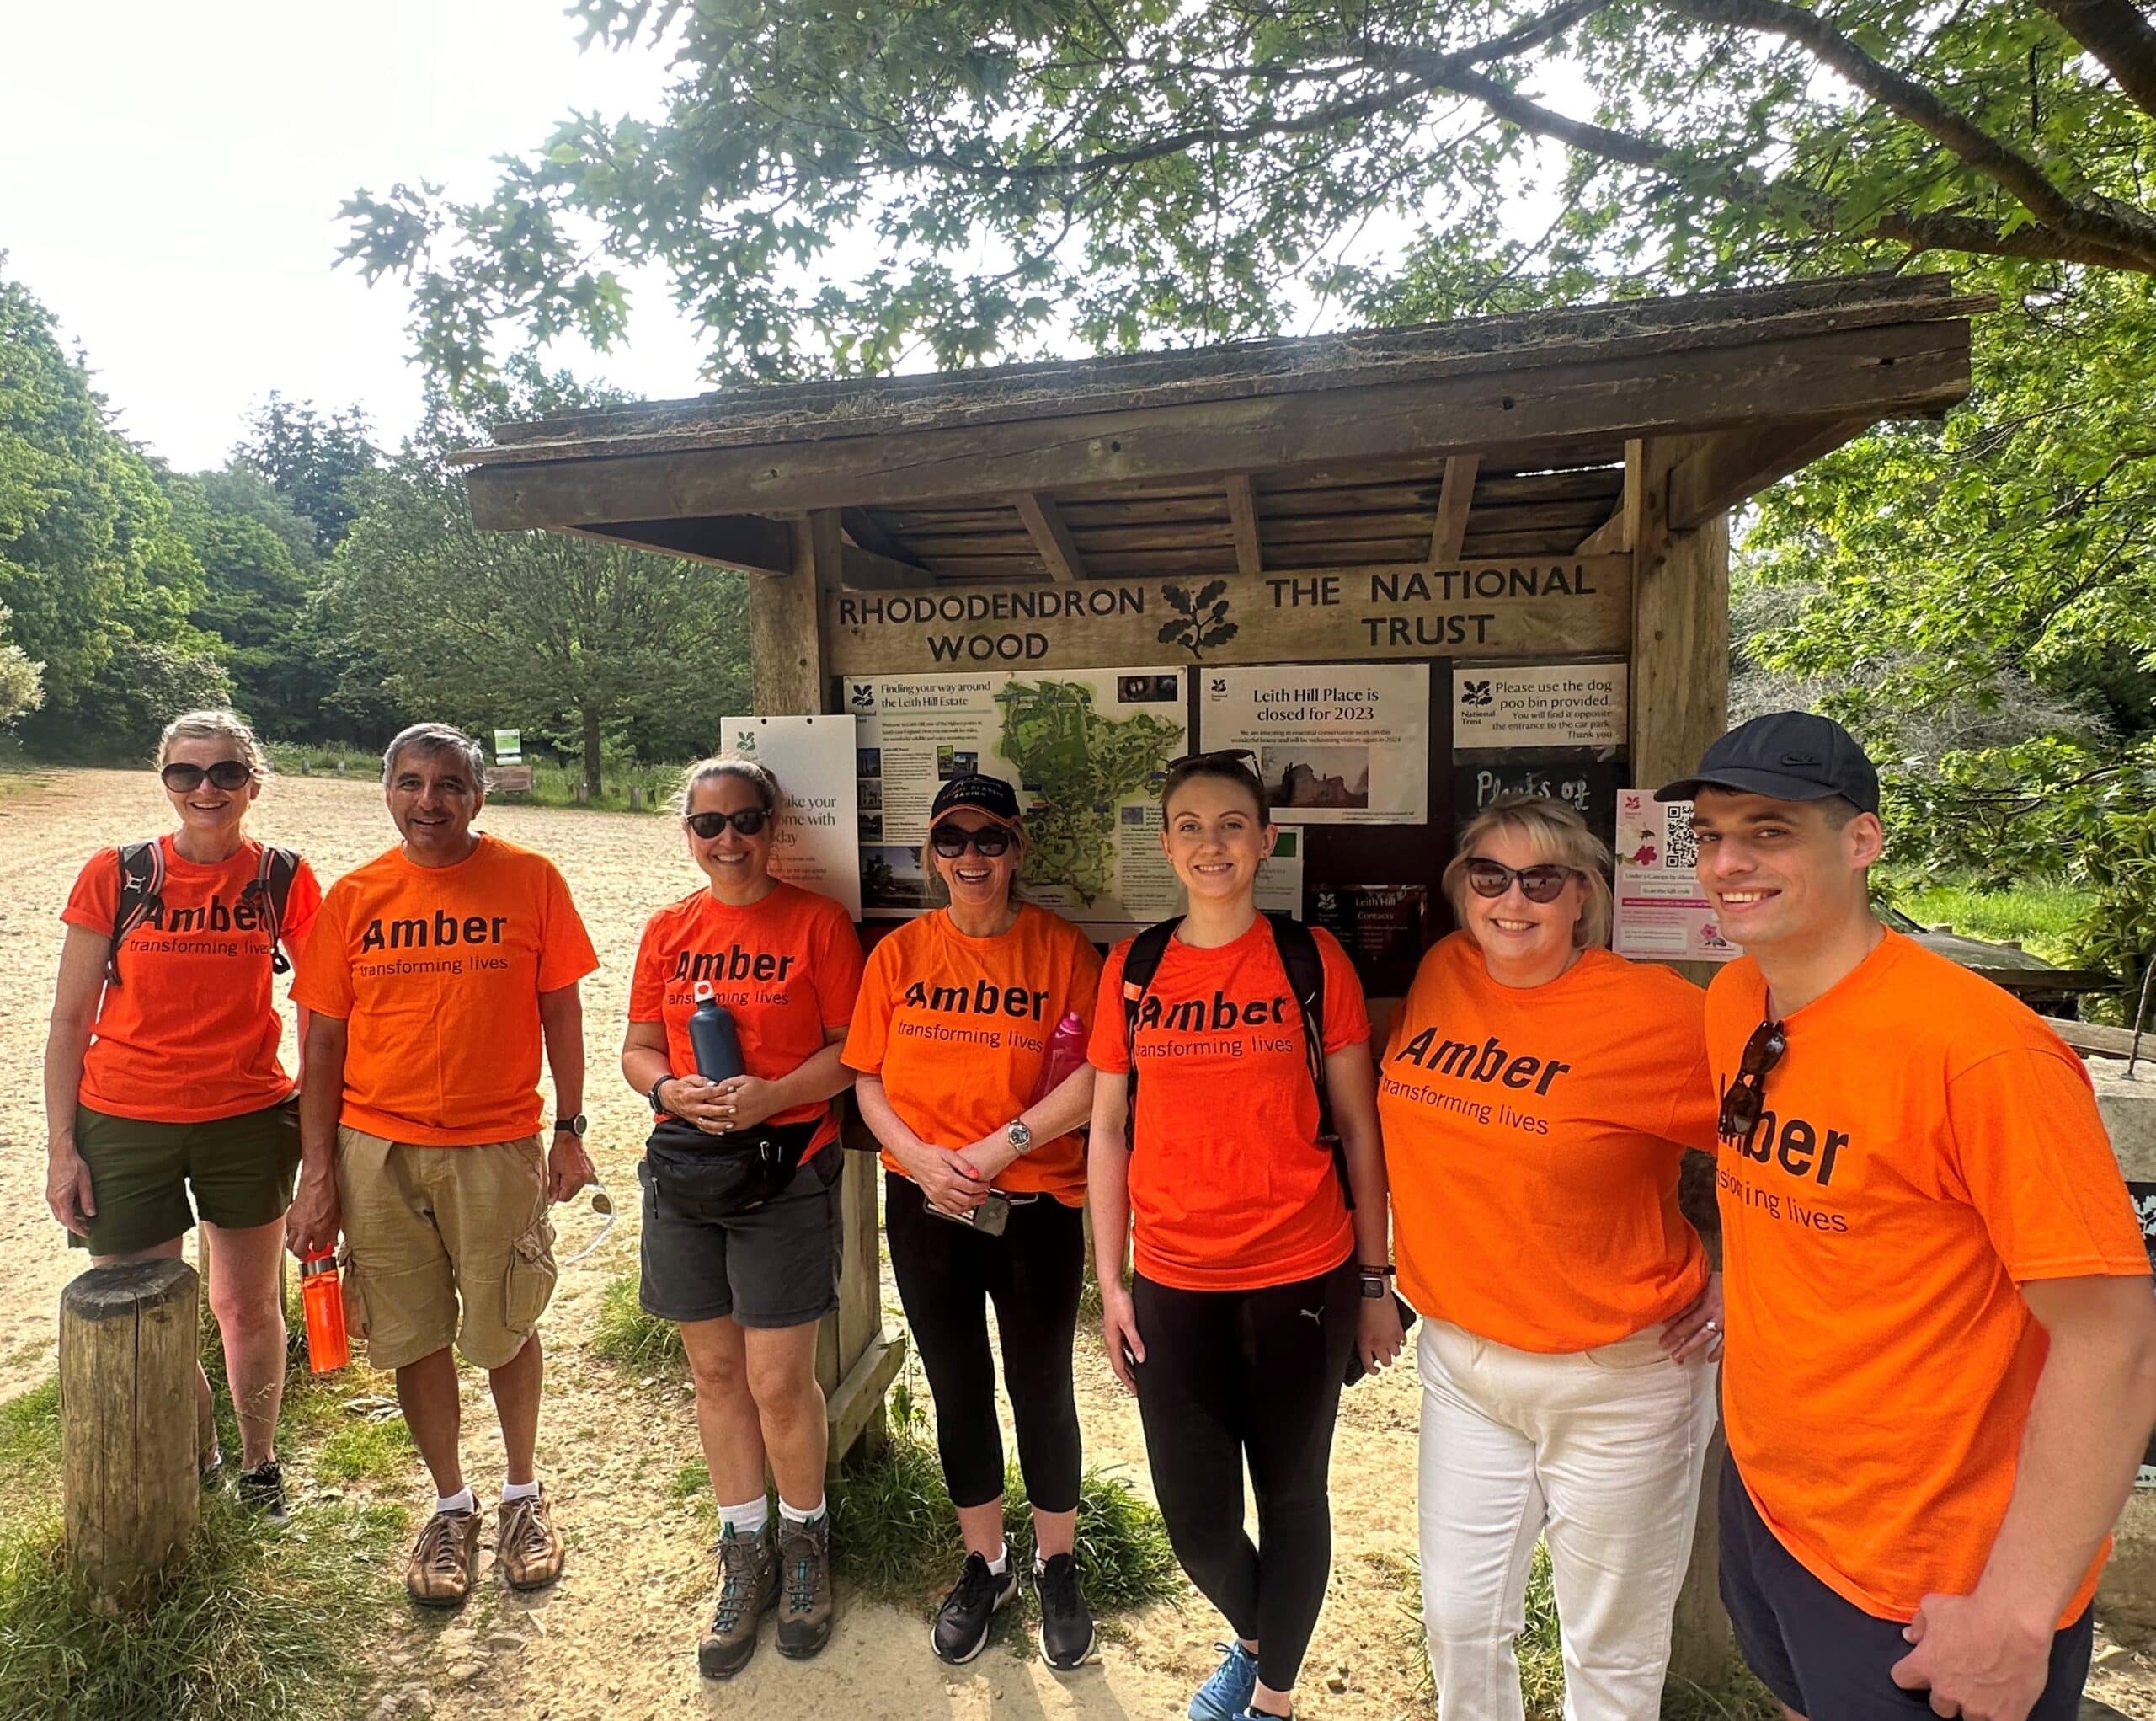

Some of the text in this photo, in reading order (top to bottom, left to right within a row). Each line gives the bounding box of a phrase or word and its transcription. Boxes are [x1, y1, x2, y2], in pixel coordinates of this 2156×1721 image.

[1266, 565, 1597, 607] THE NATIONAL
[839, 586, 1145, 625] RHODODENDRON
[1361, 614, 1495, 646] TRUST
[927, 633, 1049, 662] WOOD
[881, 681, 990, 695] Finding your way around
[1253, 687, 1379, 703] Leith Hill Place is
[1496, 680, 1612, 693] Please use the dog
[882, 697, 969, 708] the Leith Hill Estate
[1500, 695, 1609, 711] poo bin provided
[1257, 707, 1374, 721] closed for 2023
[1574, 710, 1611, 719] opposite
[1559, 720, 1573, 729] the
[1590, 720, 1609, 730] park
[1568, 730, 1594, 739] Thank
[1561, 778, 1591, 810] of
[808, 798, 837, 811] your
[808, 812, 835, 826] with
[776, 829, 798, 847] day
[1356, 897, 1396, 907] Leith Hill
[361, 909, 507, 954] Amber
[130, 938, 237, 956] transforming
[360, 955, 509, 977] transforming lives
[667, 944, 795, 983] Amber
[755, 991, 789, 1005] lives
[905, 980, 1049, 1022] Amber
[1137, 991, 1288, 1032] Amber
[898, 1019, 1044, 1053] transforming lives
[1251, 1035, 1294, 1052] lives
[1393, 1027, 1571, 1096] Amber
[1382, 1077, 1549, 1136] transforming lives
[1719, 1093, 1849, 1187] ber
[1786, 1195, 1849, 1233] lives
